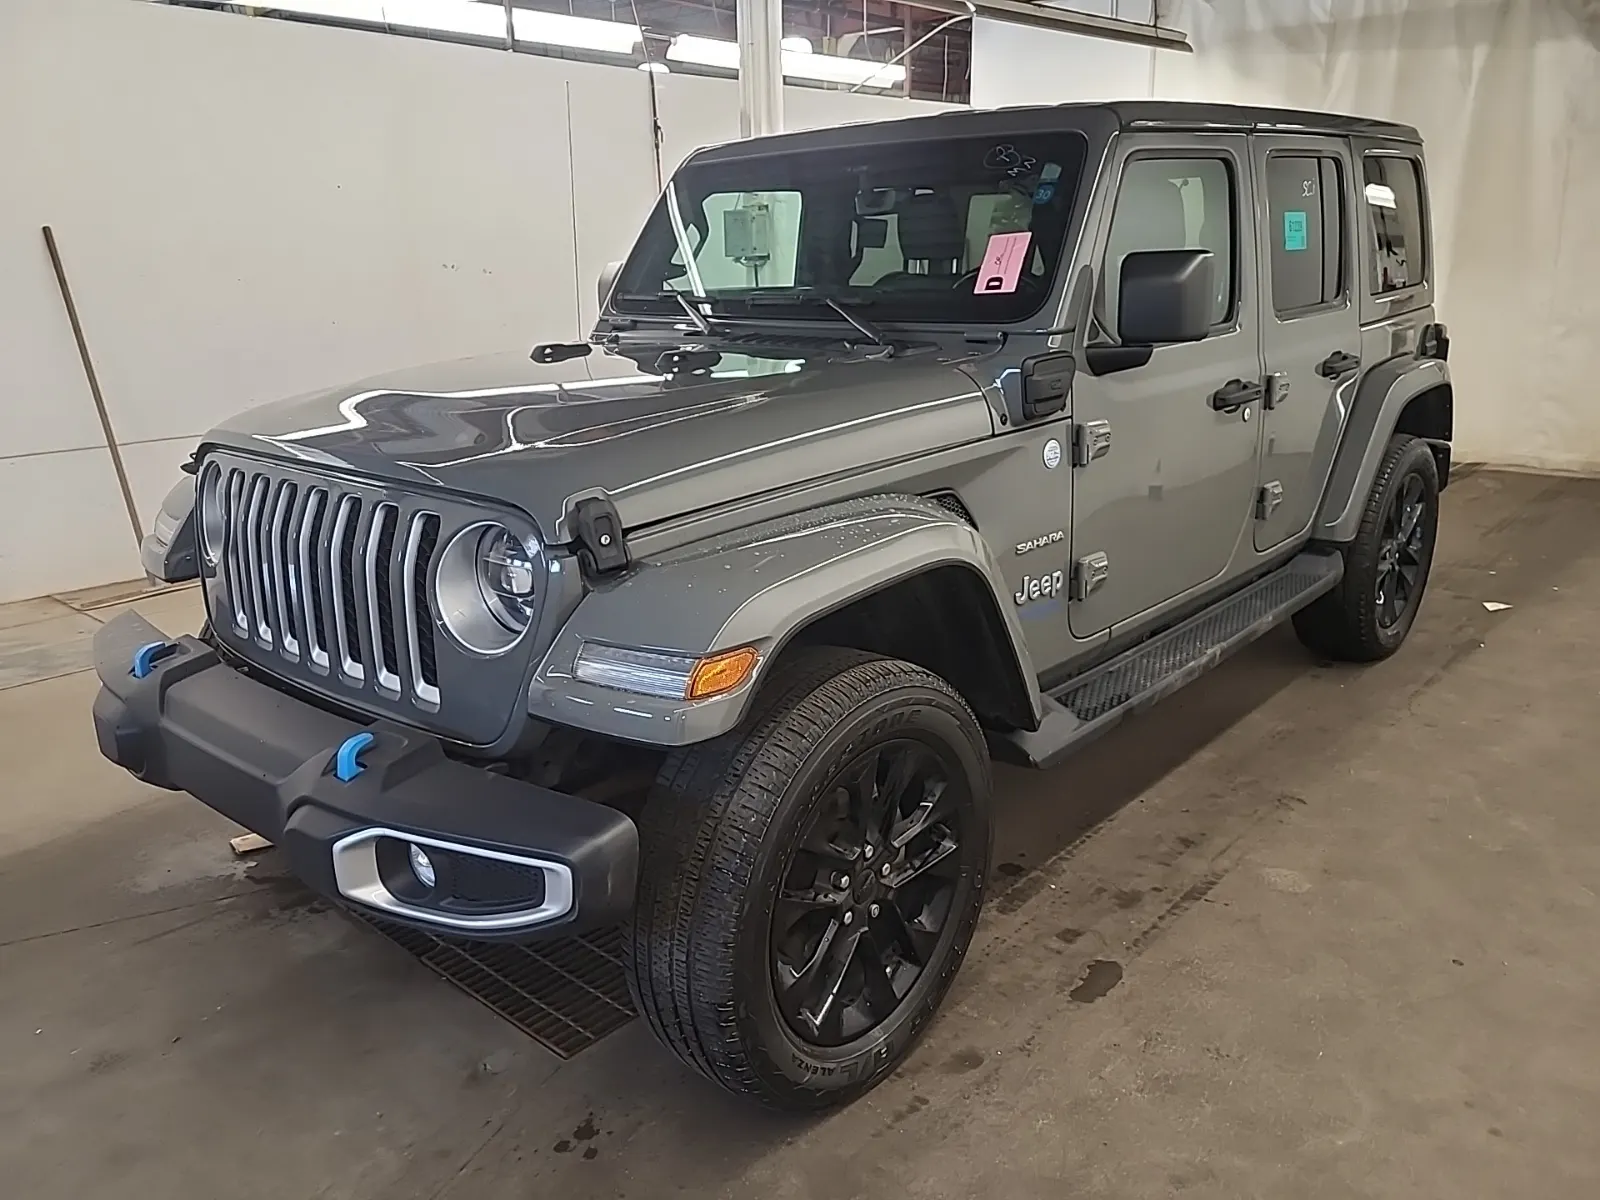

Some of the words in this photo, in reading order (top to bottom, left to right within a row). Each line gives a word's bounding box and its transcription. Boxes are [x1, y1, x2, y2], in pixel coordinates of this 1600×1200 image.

[985, 276, 1004, 291] D
[1016, 530, 1064, 554] SAHARA
[1015, 570, 1063, 605] Jeep
[791, 1052, 836, 1077] ALENZA
